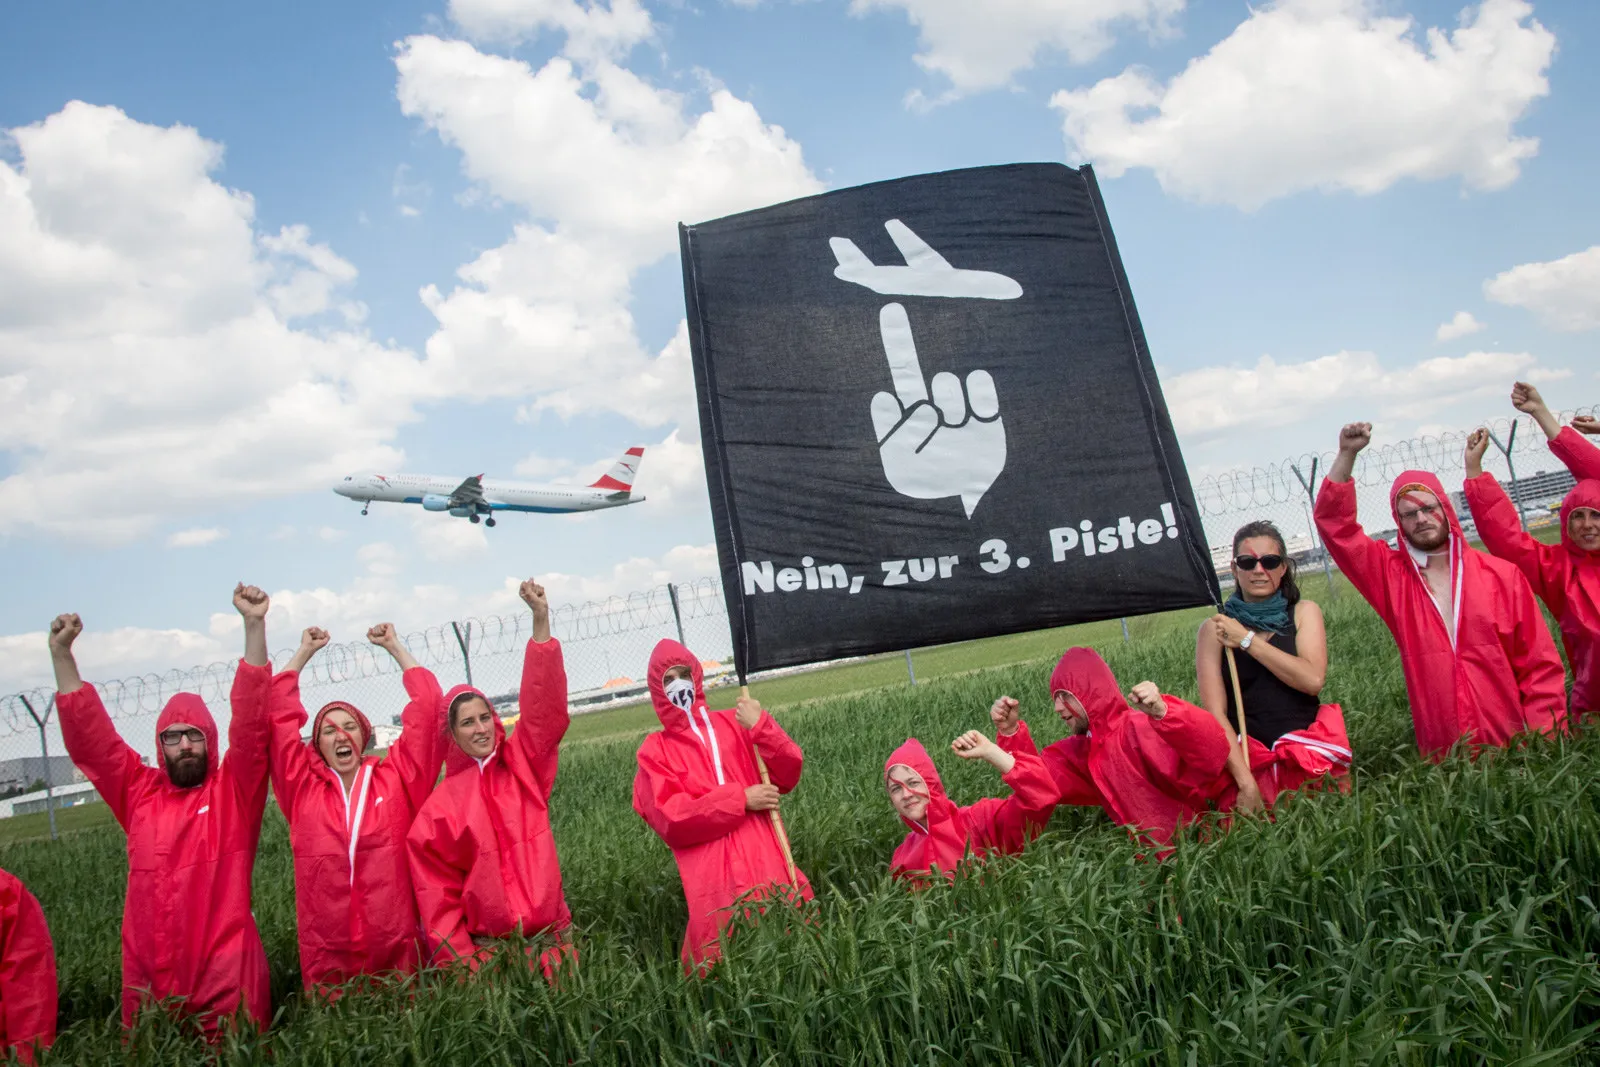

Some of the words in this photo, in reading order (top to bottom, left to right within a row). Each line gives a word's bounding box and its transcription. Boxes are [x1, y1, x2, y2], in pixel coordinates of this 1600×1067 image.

[740, 556, 865, 596] Nein,
[882, 554, 960, 586] zur
[979, 539, 1031, 574] 3.
[1049, 502, 1179, 563] Piste!
